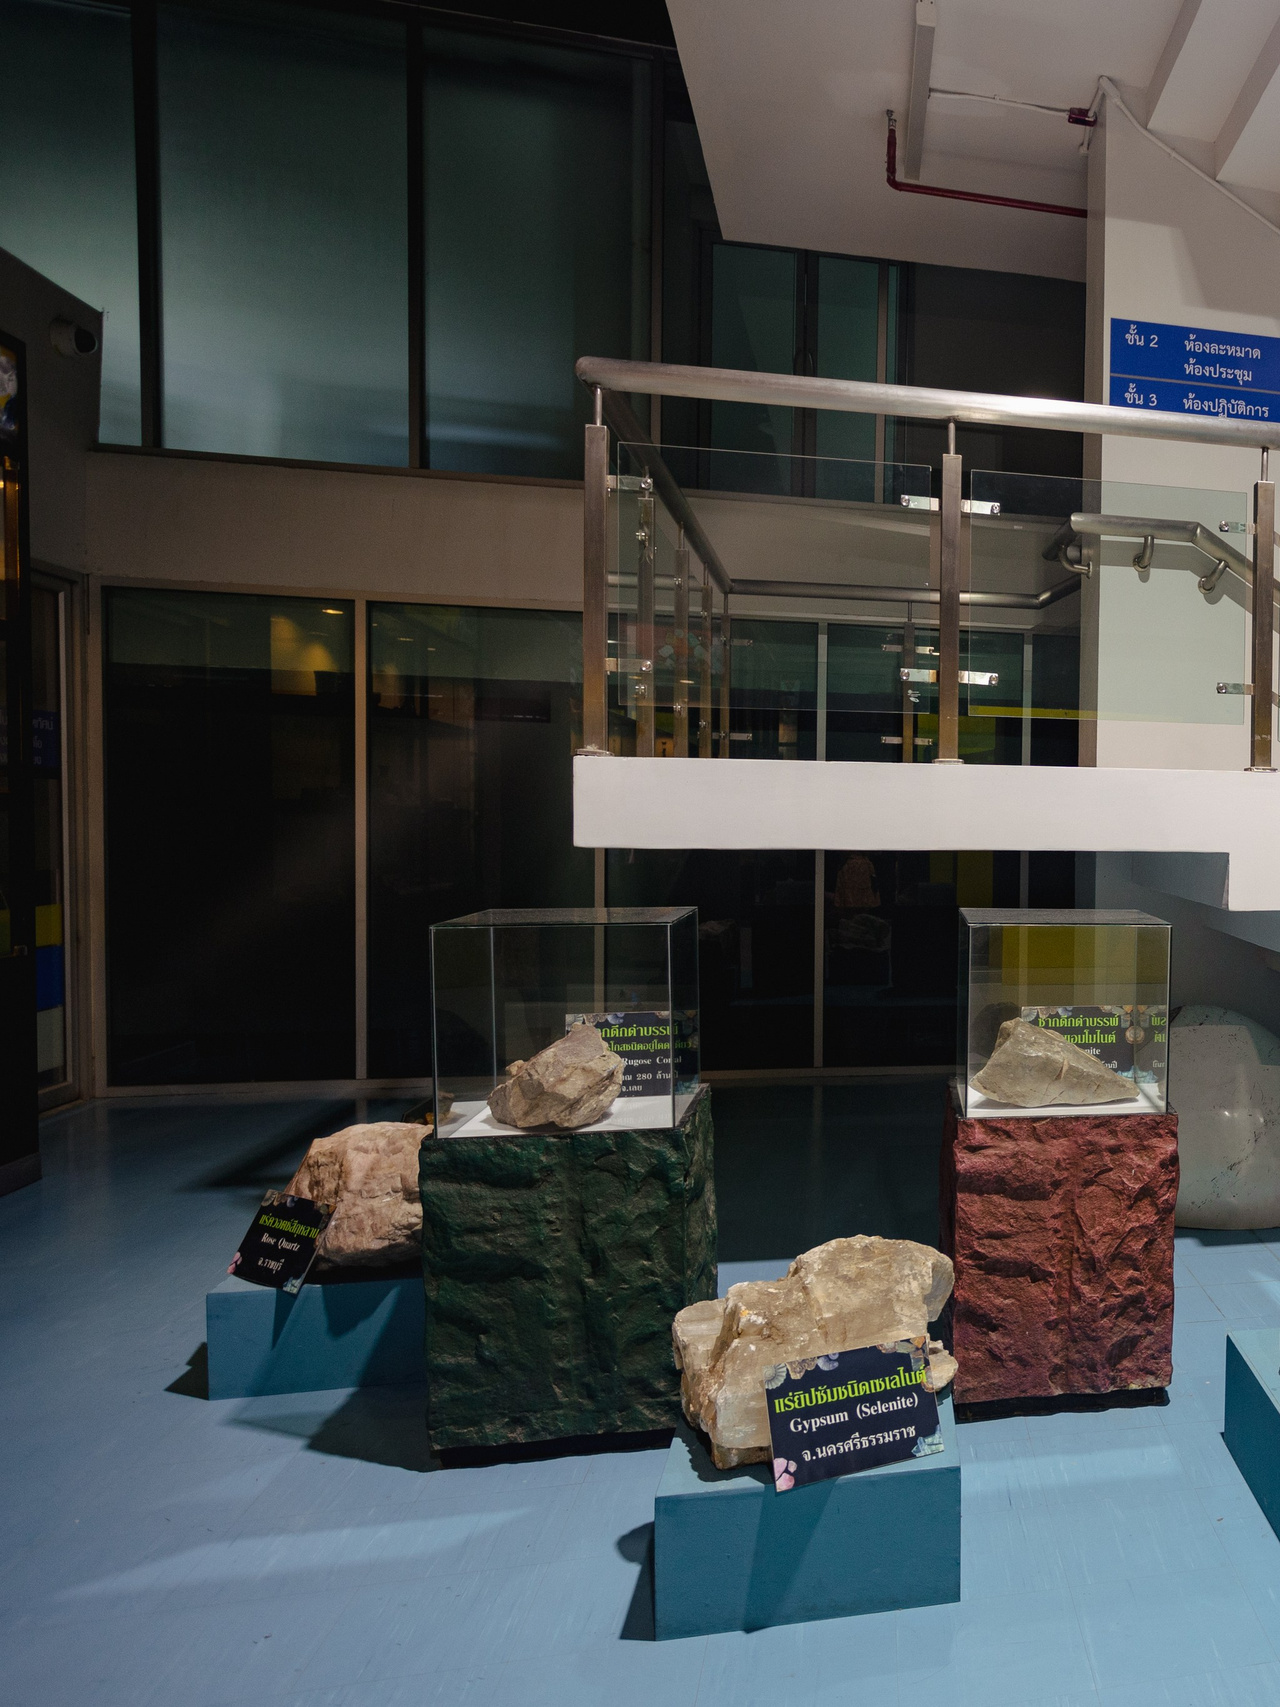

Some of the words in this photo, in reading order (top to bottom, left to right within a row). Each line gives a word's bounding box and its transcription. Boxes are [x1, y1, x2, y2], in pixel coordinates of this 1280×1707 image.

[1125, 324, 1145, 347] ชั้น
[1149, 335, 1158, 348] 2
[1184, 334, 1261, 360] ห้องละหมาด
[1184, 358, 1252, 386] ห้องประชุม
[1124, 383, 1144, 406] ชั้น
[1148, 394, 1158, 407] 3
[1182, 392, 1269, 418] ห้องปฏิบัติการ
[636, 1073, 653, 1081] 280
[261, 1232, 277, 1246] Rose
[277, 1237, 301, 1252] Quartz
[789, 1411, 849, 1434] Gypsum
[856, 1392, 919, 1420] (Selenite)
[801, 1424, 916, 1462] จ.นครศรีธรรมราช
